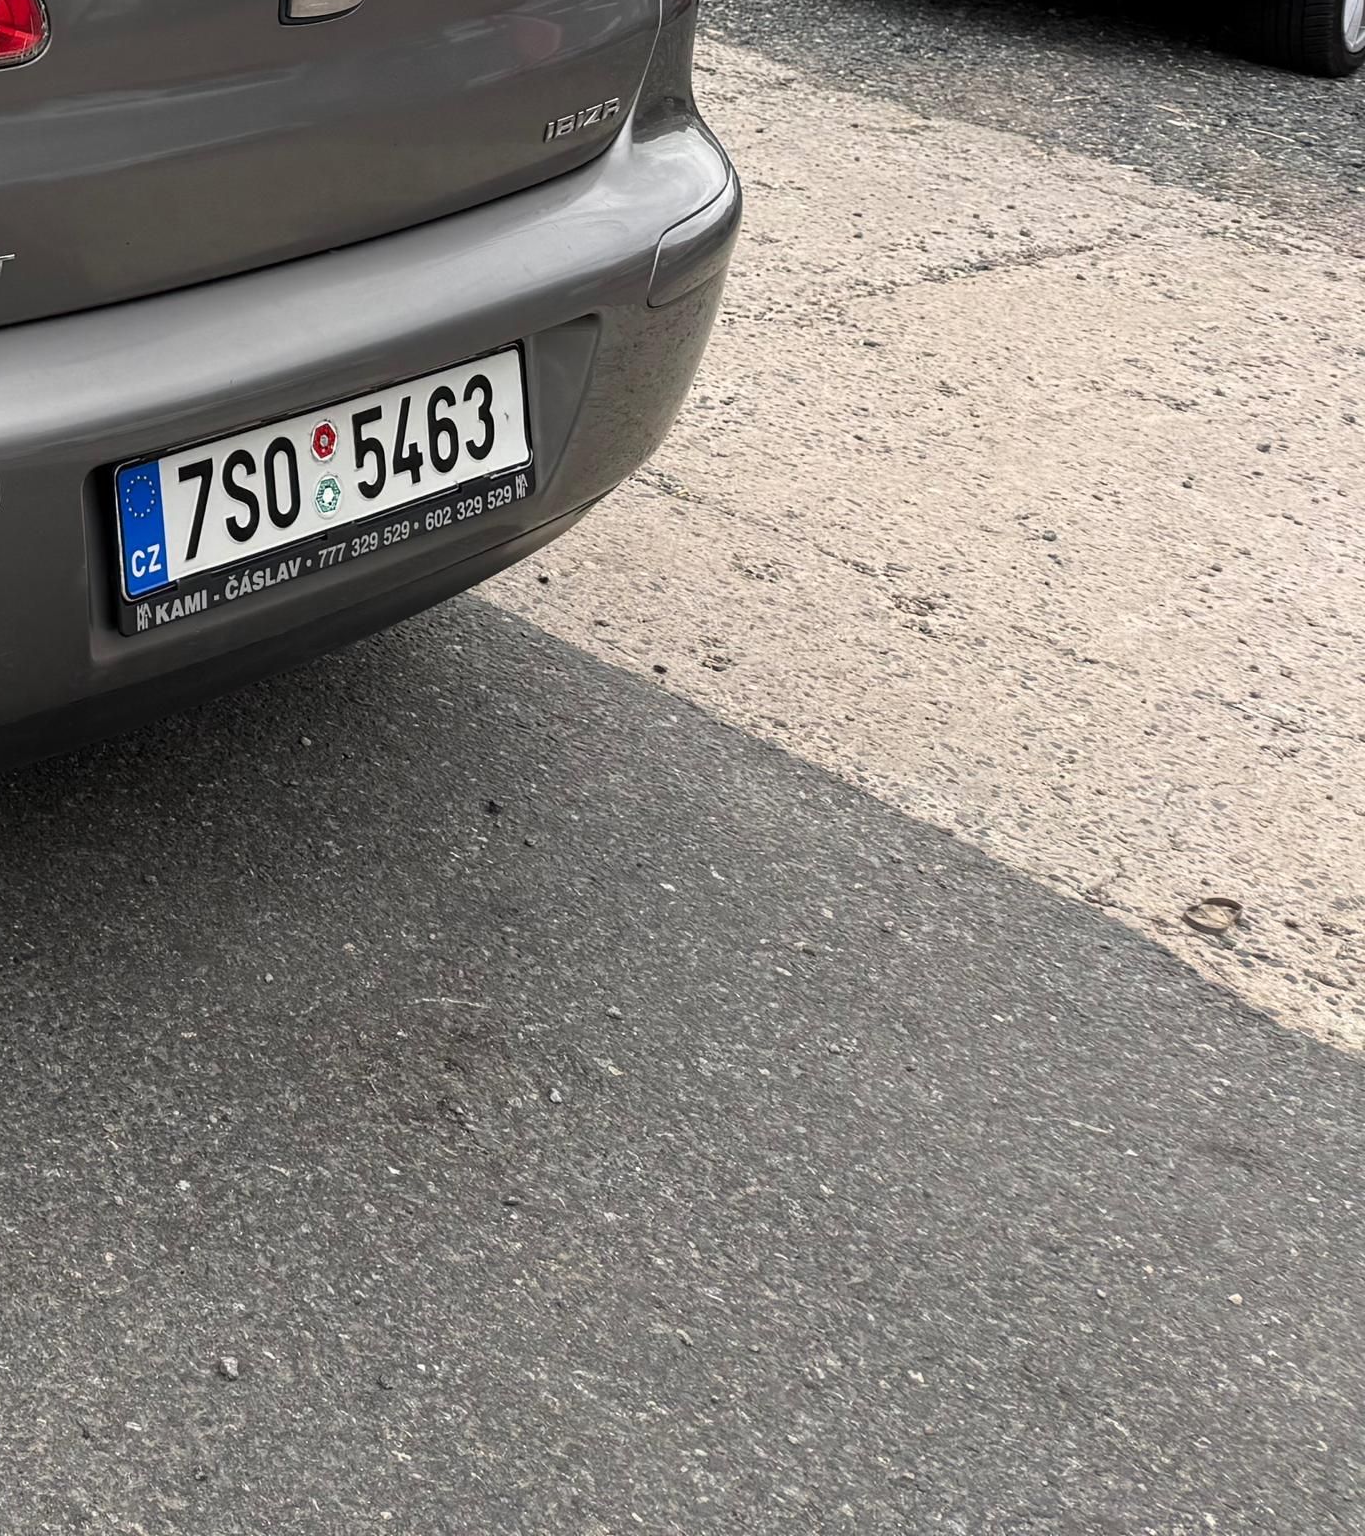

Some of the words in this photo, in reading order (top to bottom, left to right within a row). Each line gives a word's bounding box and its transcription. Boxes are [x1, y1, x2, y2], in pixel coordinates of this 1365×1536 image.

[543, 97, 620, 144] IBIZA
[351, 373, 496, 500] 5463
[131, 543, 162, 578] CZ
[156, 589, 208, 625] KAMI
[225, 557, 302, 601] ČÁSLAV
[318, 542, 347, 568] 777
[351, 531, 378, 559] 329
[383, 520, 410, 546] 529
[425, 506, 452, 531] 602
[456, 495, 483, 520] 329
[486, 485, 512, 510] 529
